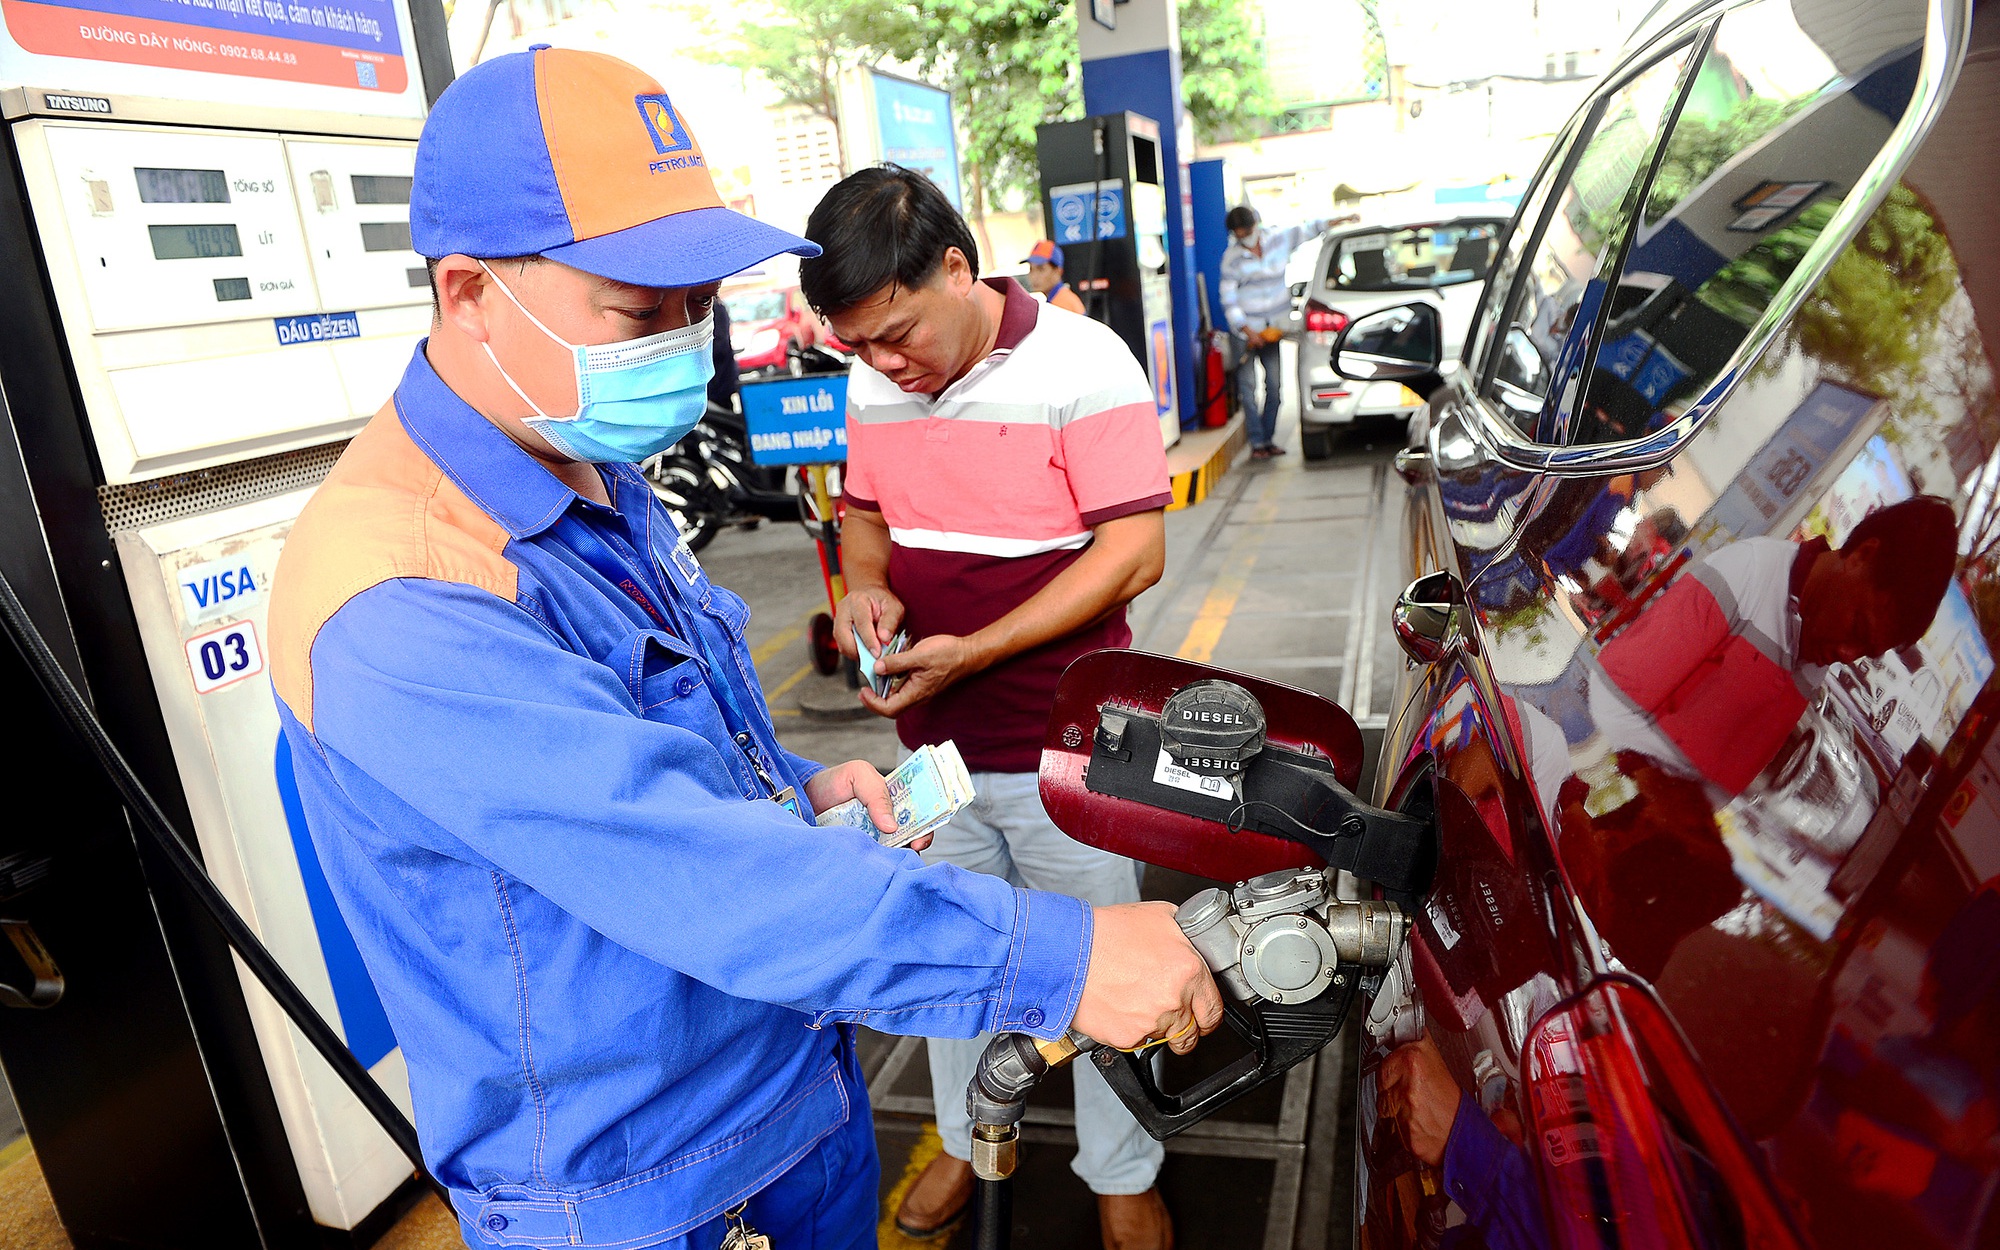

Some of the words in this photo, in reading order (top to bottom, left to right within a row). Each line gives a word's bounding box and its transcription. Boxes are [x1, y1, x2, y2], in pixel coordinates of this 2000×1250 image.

[79, 25, 136, 45] ĐƯỜNG
[139, 31, 169, 49] DÂY
[173, 36, 217, 55] NÓNG:
[219, 43, 298, 65] 0902.68.44.88
[46, 95, 110, 114] TATSUNO
[781, 395, 809, 415] XIN
[182, 566, 256, 608] VISA
[200, 632, 250, 681] 03
[1183, 710, 1243, 725] DIESEL
[1164, 766, 1191, 779] DIESEL
